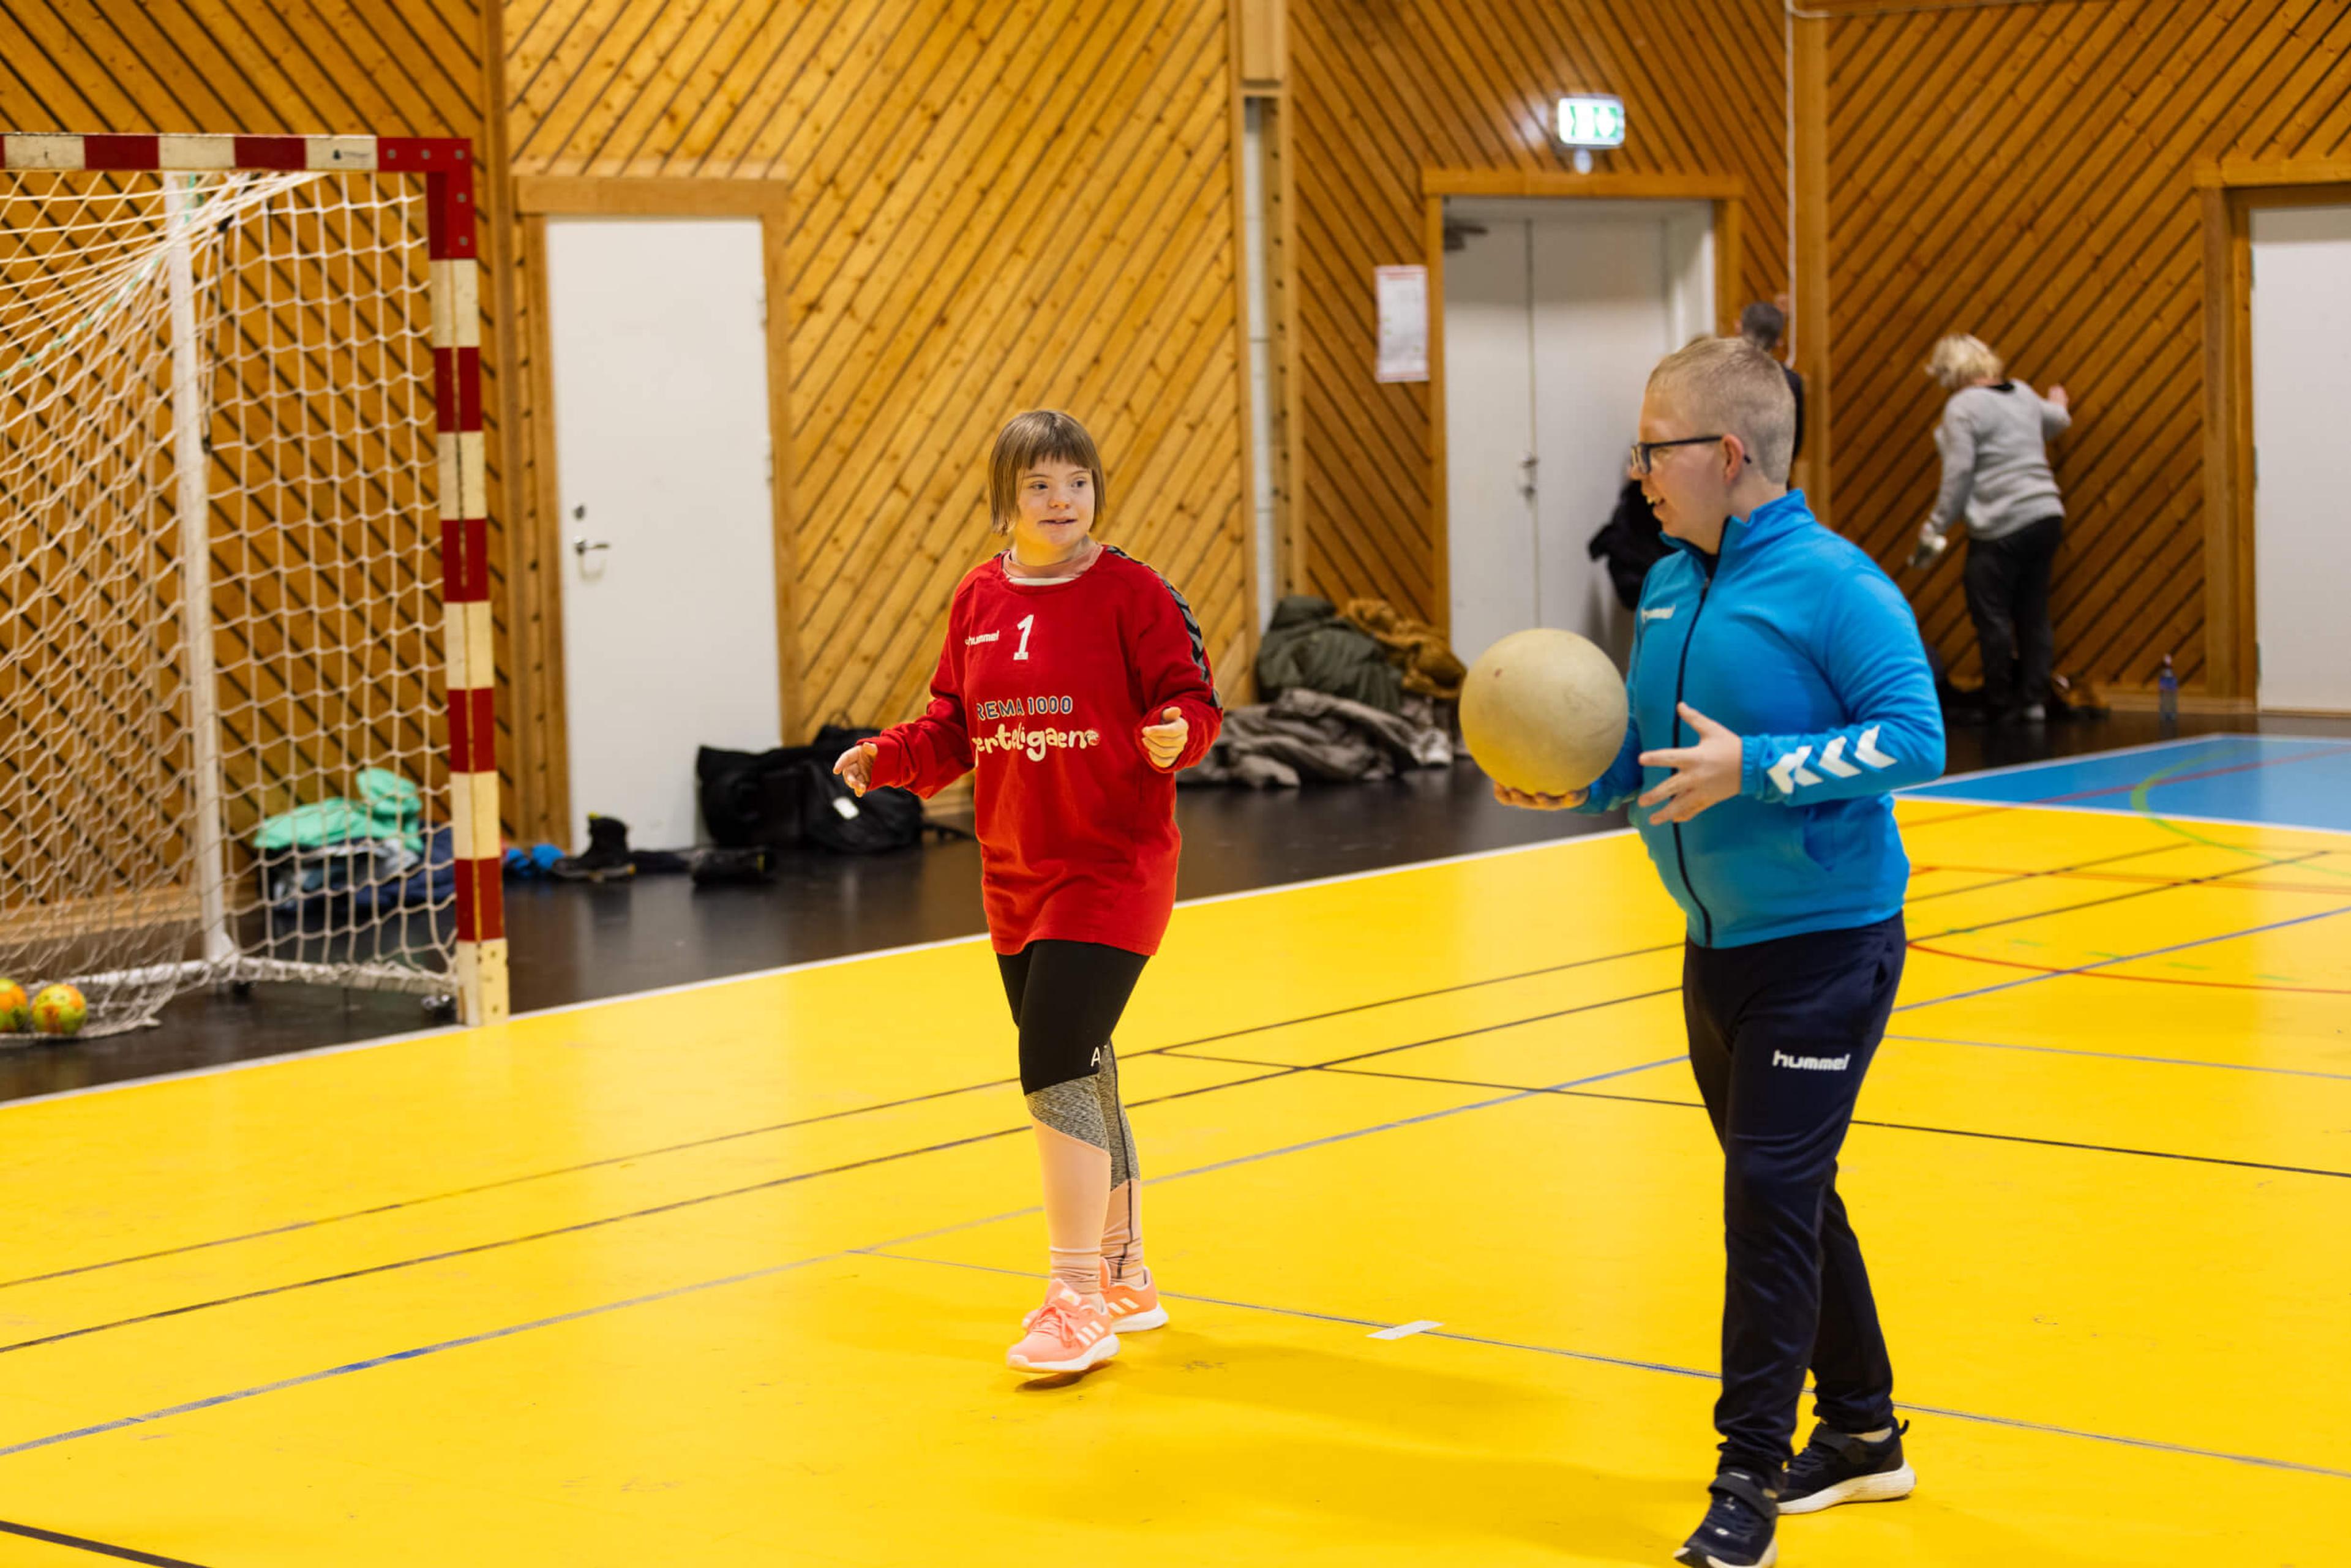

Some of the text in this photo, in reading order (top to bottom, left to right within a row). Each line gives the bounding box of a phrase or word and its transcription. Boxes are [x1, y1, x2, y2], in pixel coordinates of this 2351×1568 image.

[1013, 614, 1034, 660] 1
[977, 696, 1073, 721] REMA 1000
[1772, 1049, 1851, 1070] hummel
